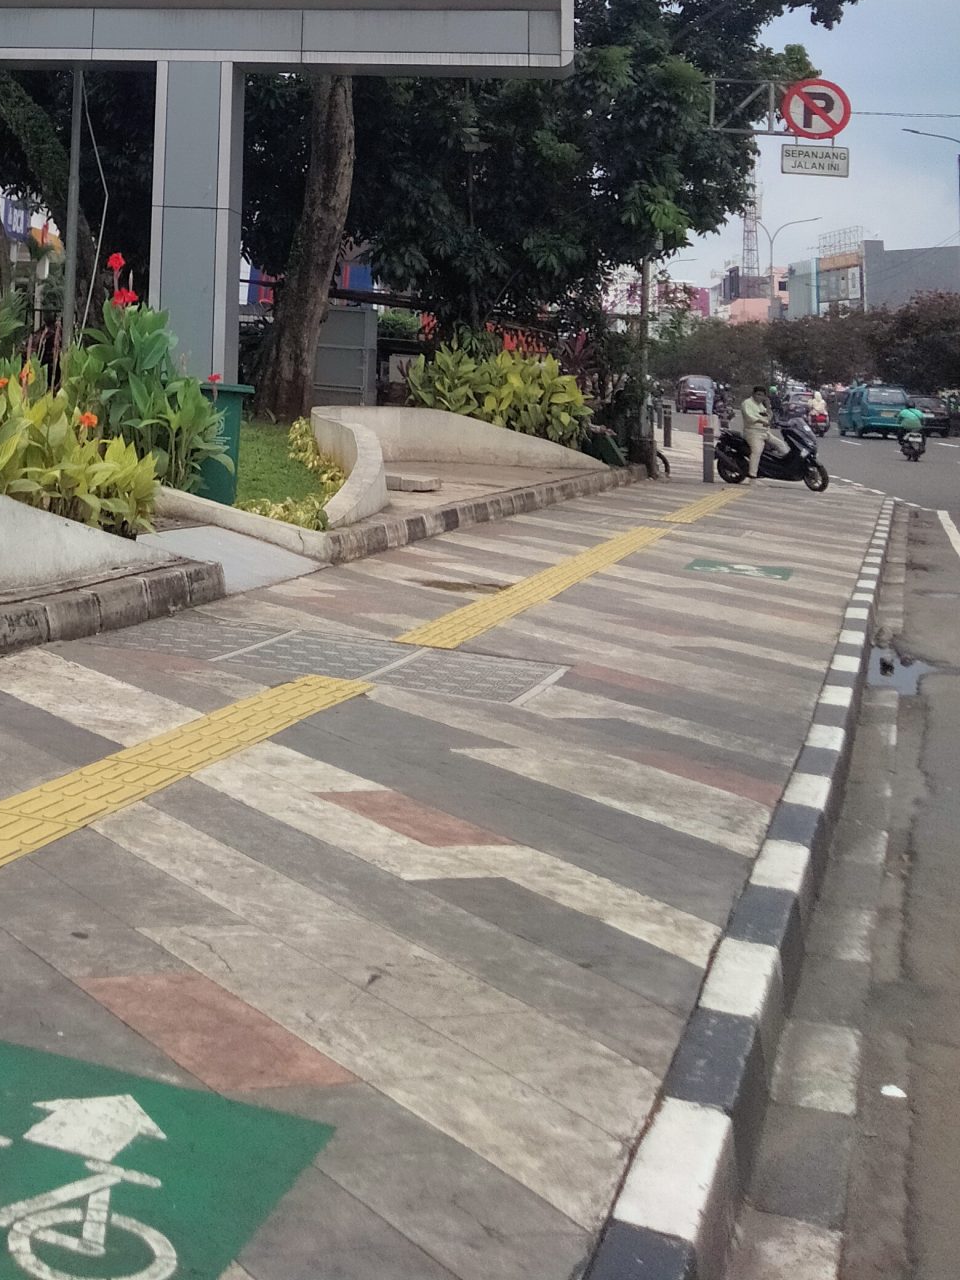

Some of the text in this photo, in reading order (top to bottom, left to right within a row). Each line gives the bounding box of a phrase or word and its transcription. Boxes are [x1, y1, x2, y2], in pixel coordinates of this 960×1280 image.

[803, 92, 834, 128] P
[784, 149, 847, 160] SEPANJANG
[791, 161, 840, 172] JALAN INI
